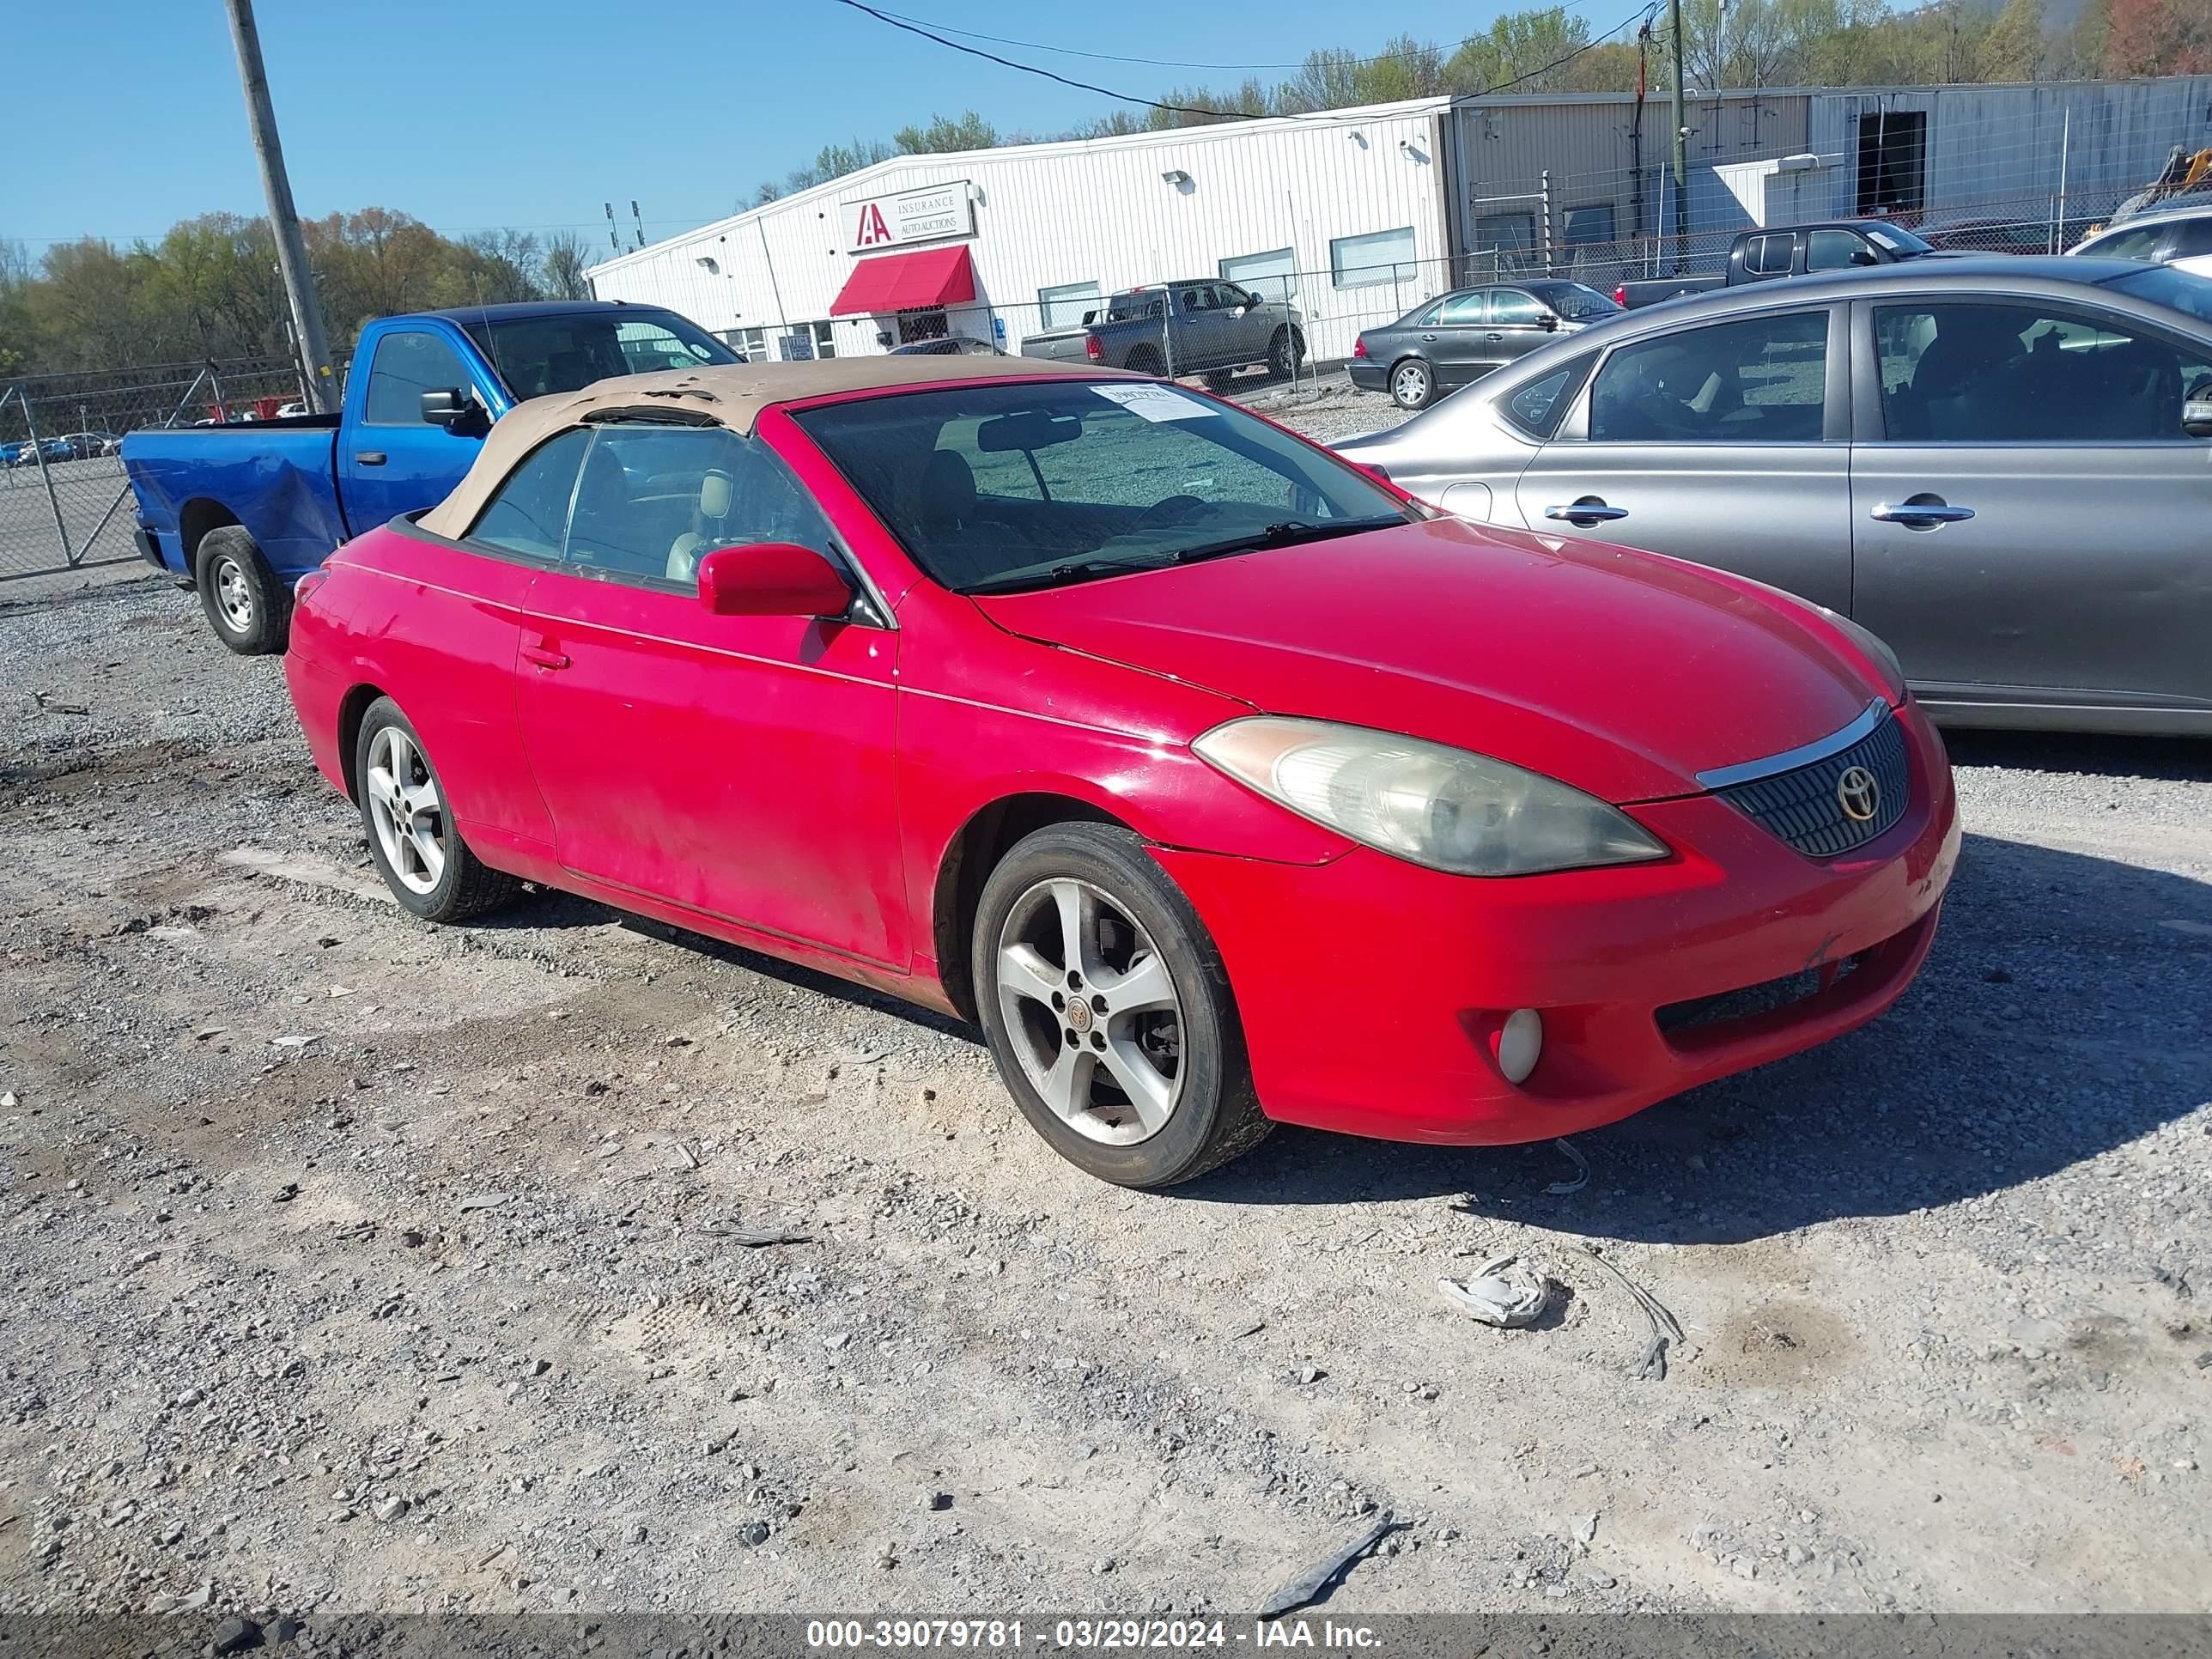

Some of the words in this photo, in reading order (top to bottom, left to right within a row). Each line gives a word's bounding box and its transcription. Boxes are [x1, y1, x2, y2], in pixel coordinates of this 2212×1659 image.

[898, 196, 954, 215] INSURANCE
[902, 221, 921, 234] AUTO
[921, 216, 957, 232] AUCTIONS
